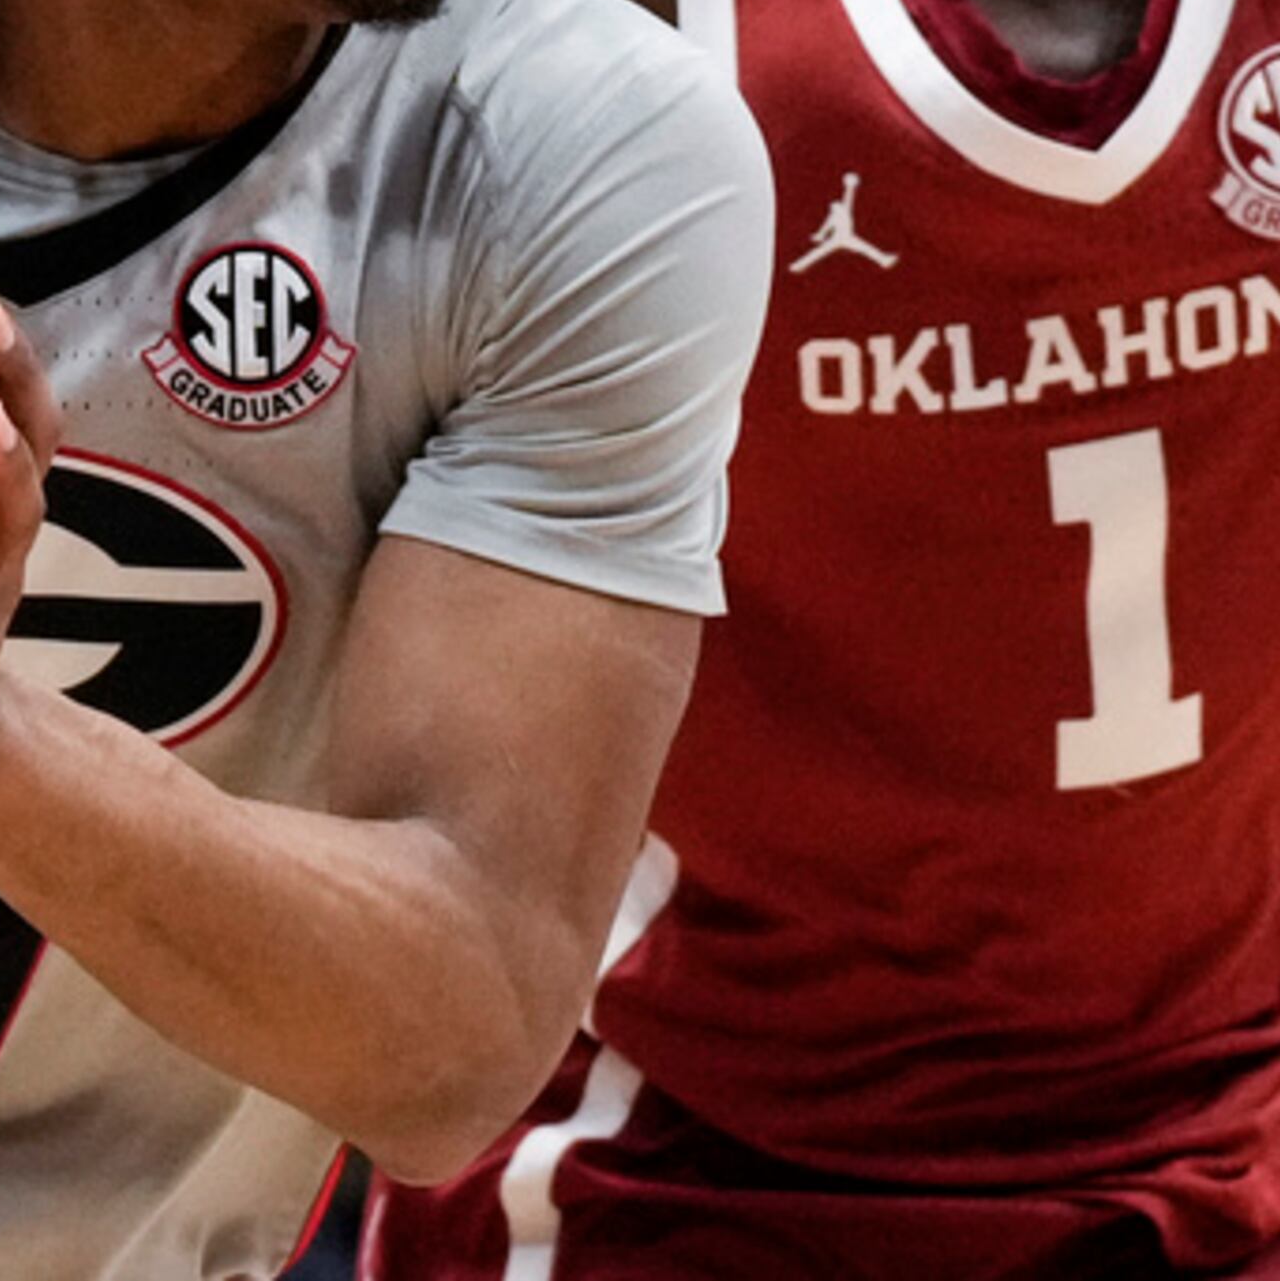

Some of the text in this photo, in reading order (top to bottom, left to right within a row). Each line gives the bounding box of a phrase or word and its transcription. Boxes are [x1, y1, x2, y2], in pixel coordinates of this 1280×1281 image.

[186, 249, 311, 380] SEC
[170, 367, 327, 422] GRADUATE
[1047, 427, 1203, 791] 1
